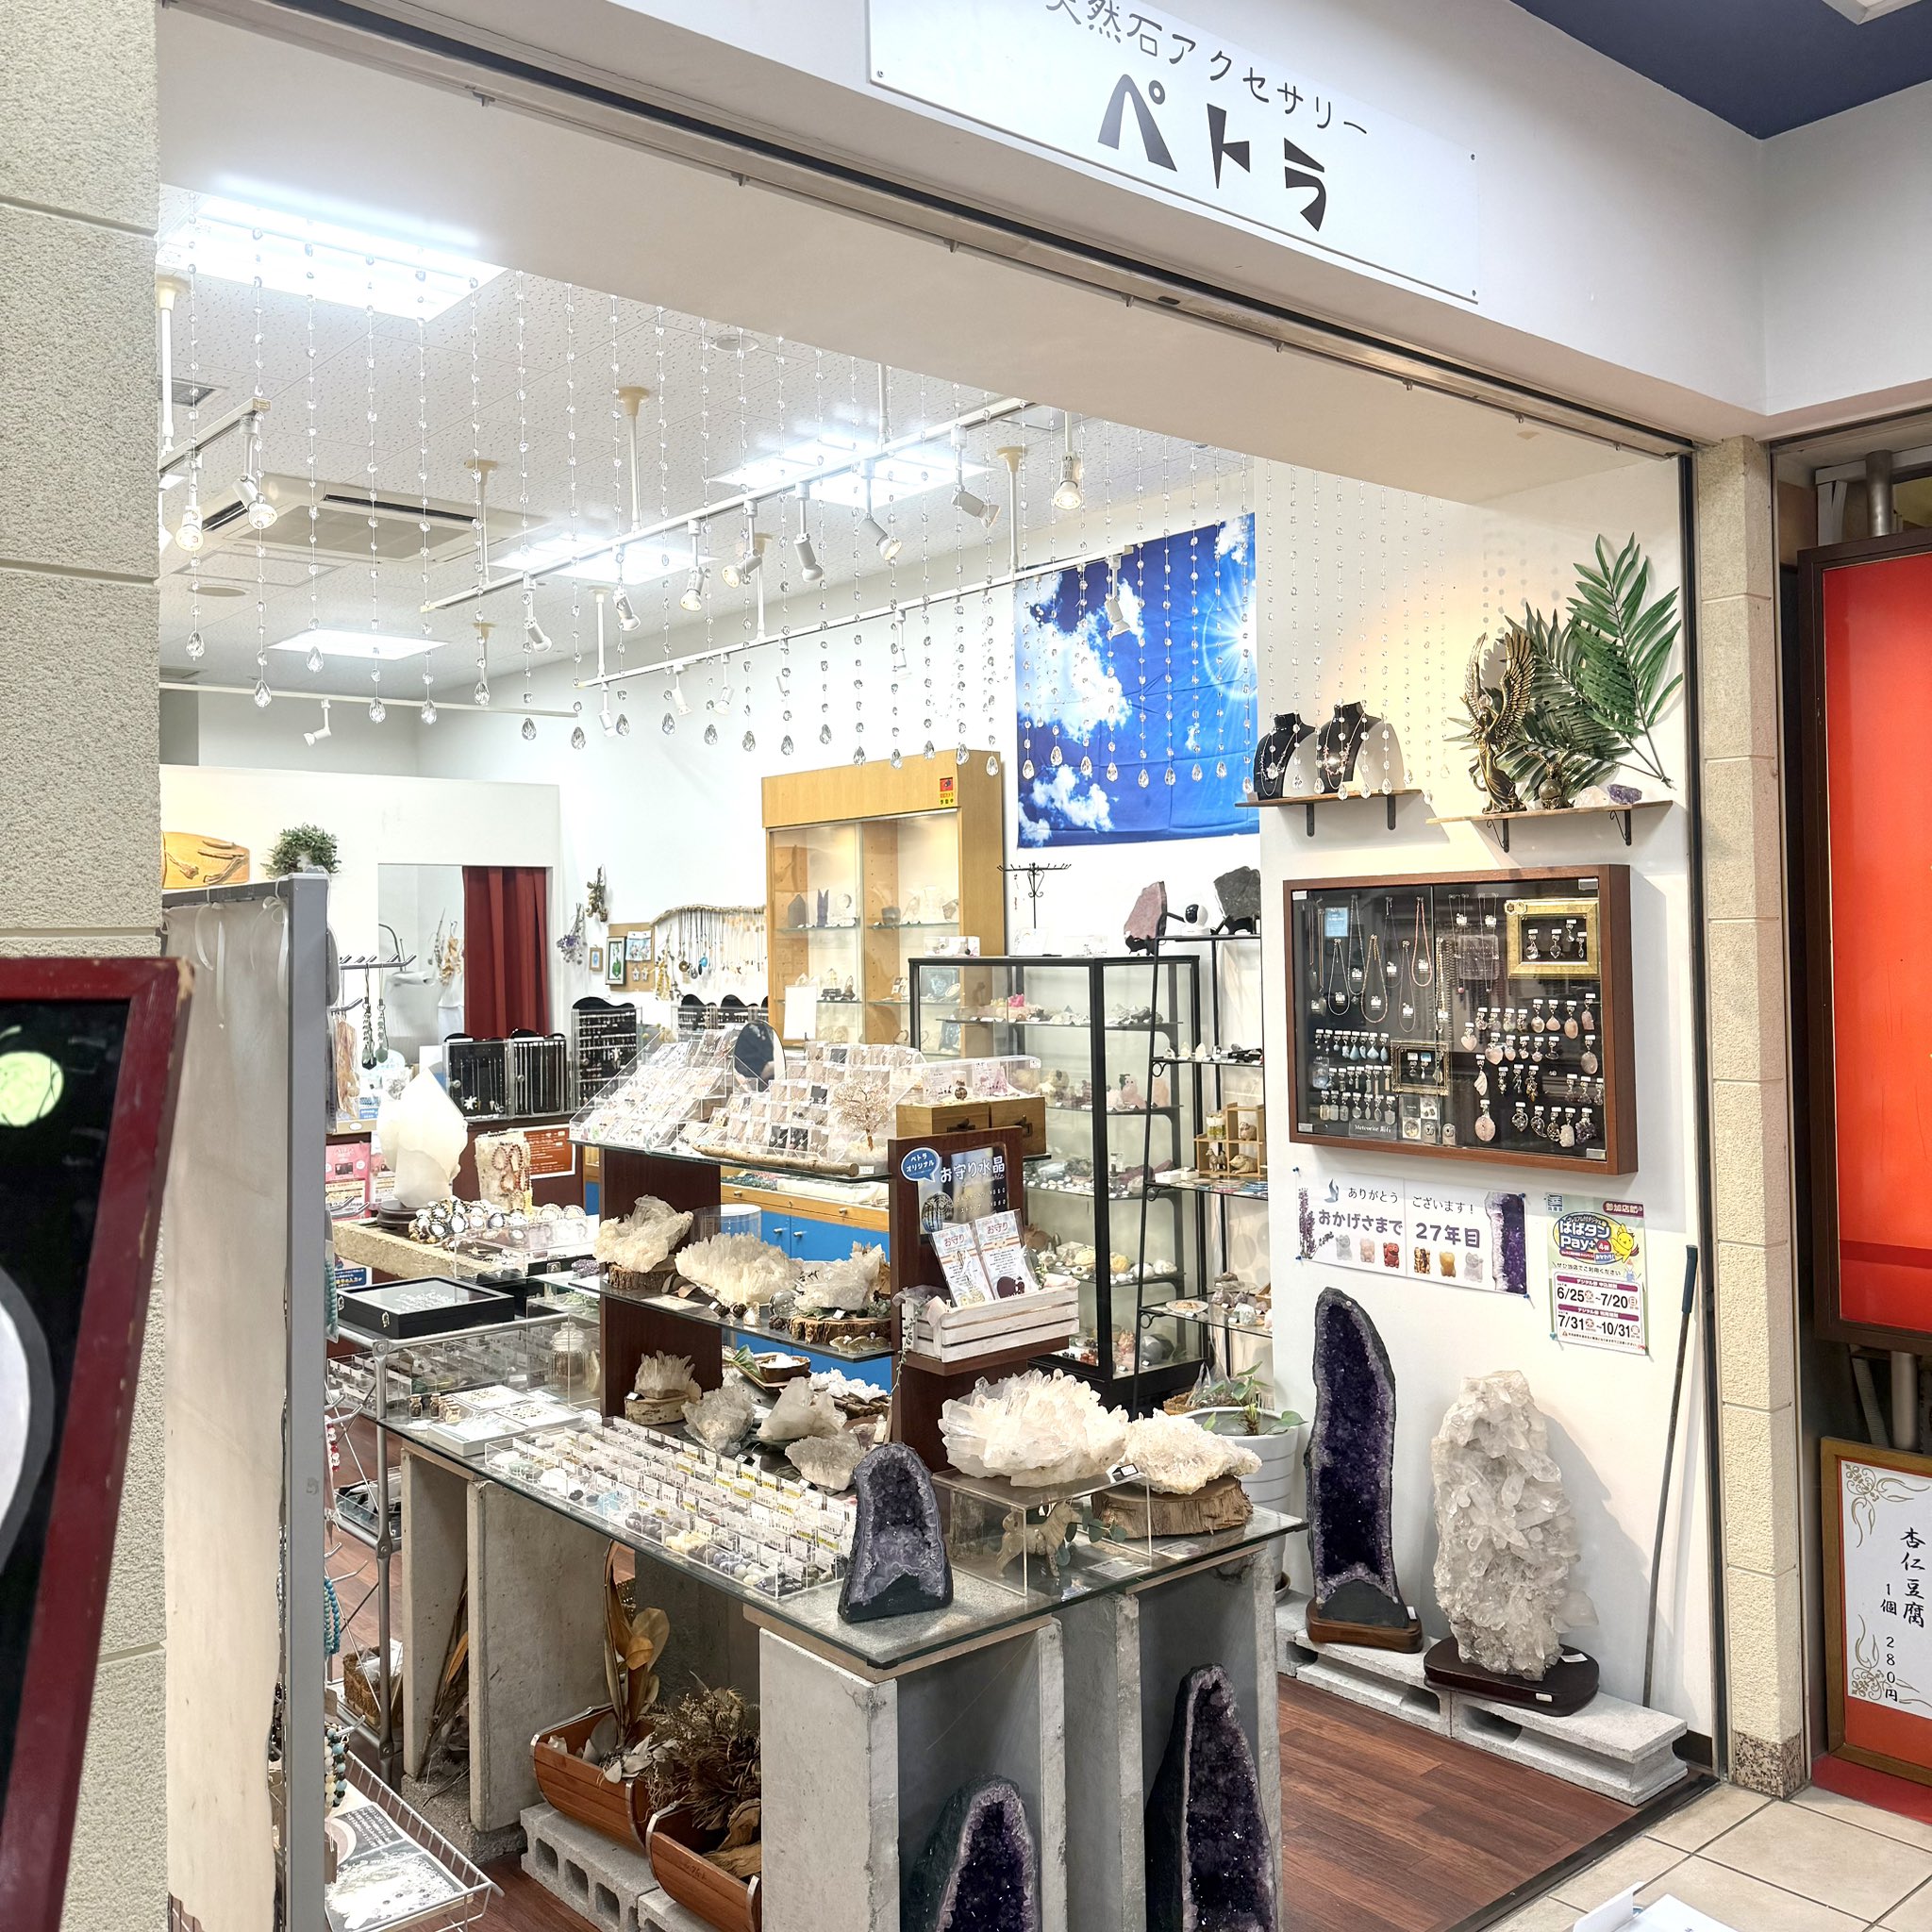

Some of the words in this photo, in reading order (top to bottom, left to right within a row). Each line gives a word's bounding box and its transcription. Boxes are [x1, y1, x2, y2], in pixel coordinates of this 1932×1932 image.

[1097, 74, 1326, 232] ペトラ
[910, 1153, 927, 1162] ペトラ
[940, 1156, 1005, 1184] お守り水晶
[1348, 1187, 1398, 1204] ありがとう
[987, 1222, 1008, 1235] お守り
[1319, 1208, 1404, 1237] おかげさまで
[1415, 1222, 1480, 1249] 27年目
[1558, 1220, 1610, 1239] はばタン
[944, 1234, 965, 1247] お守り
[1560, 1235, 1596, 1251] Pay+
[1899, 1526, 1926, 1628] 杏仁豆腐
[1880, 1583, 1898, 1616] 1個
[1885, 1636, 1898, 1702] 280円
